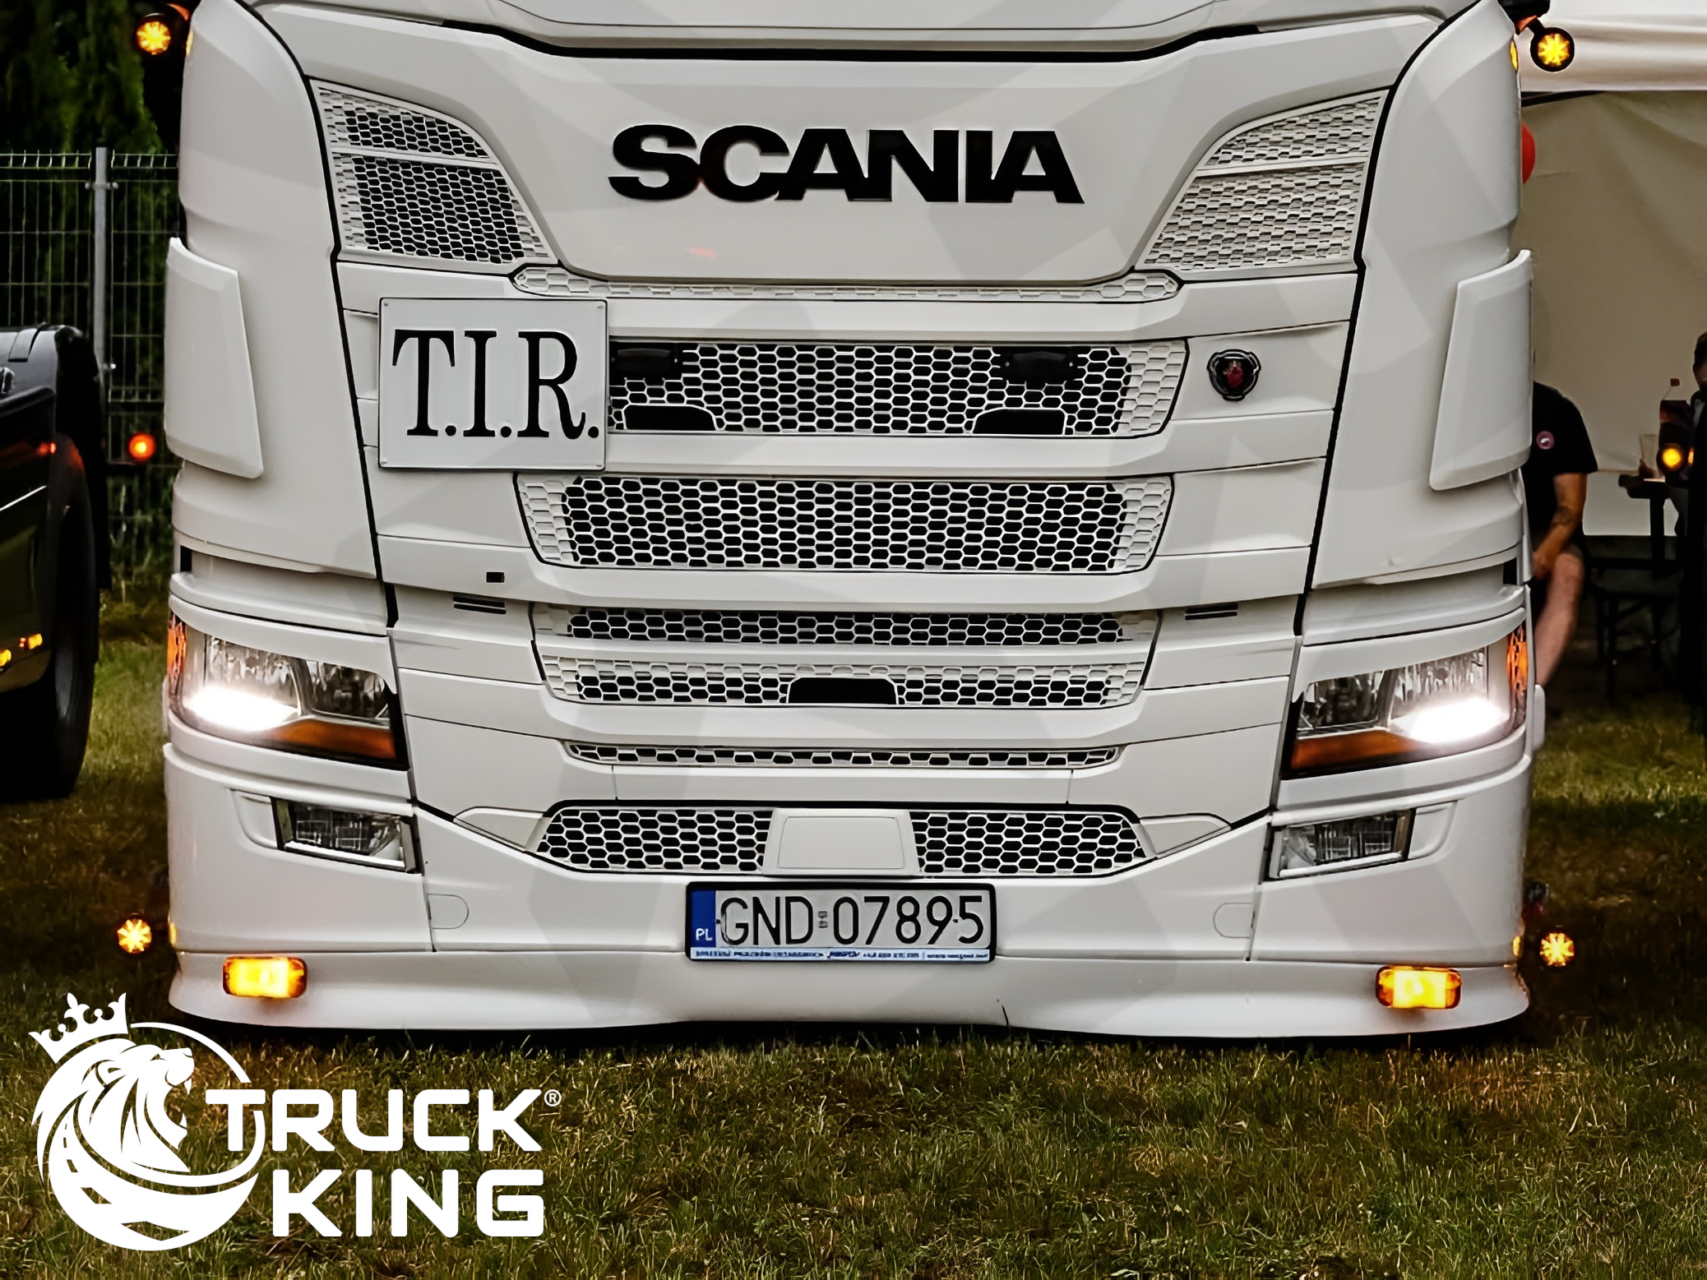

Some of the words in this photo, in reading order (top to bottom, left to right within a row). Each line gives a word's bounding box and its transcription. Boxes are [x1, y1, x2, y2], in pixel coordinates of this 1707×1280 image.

[608, 124, 1085, 204] SCANIA
[392, 329, 599, 440] T.I.R.
[695, 928, 713, 941] PL
[720, 896, 814, 946] GND
[832, 895, 984, 946] 07895
